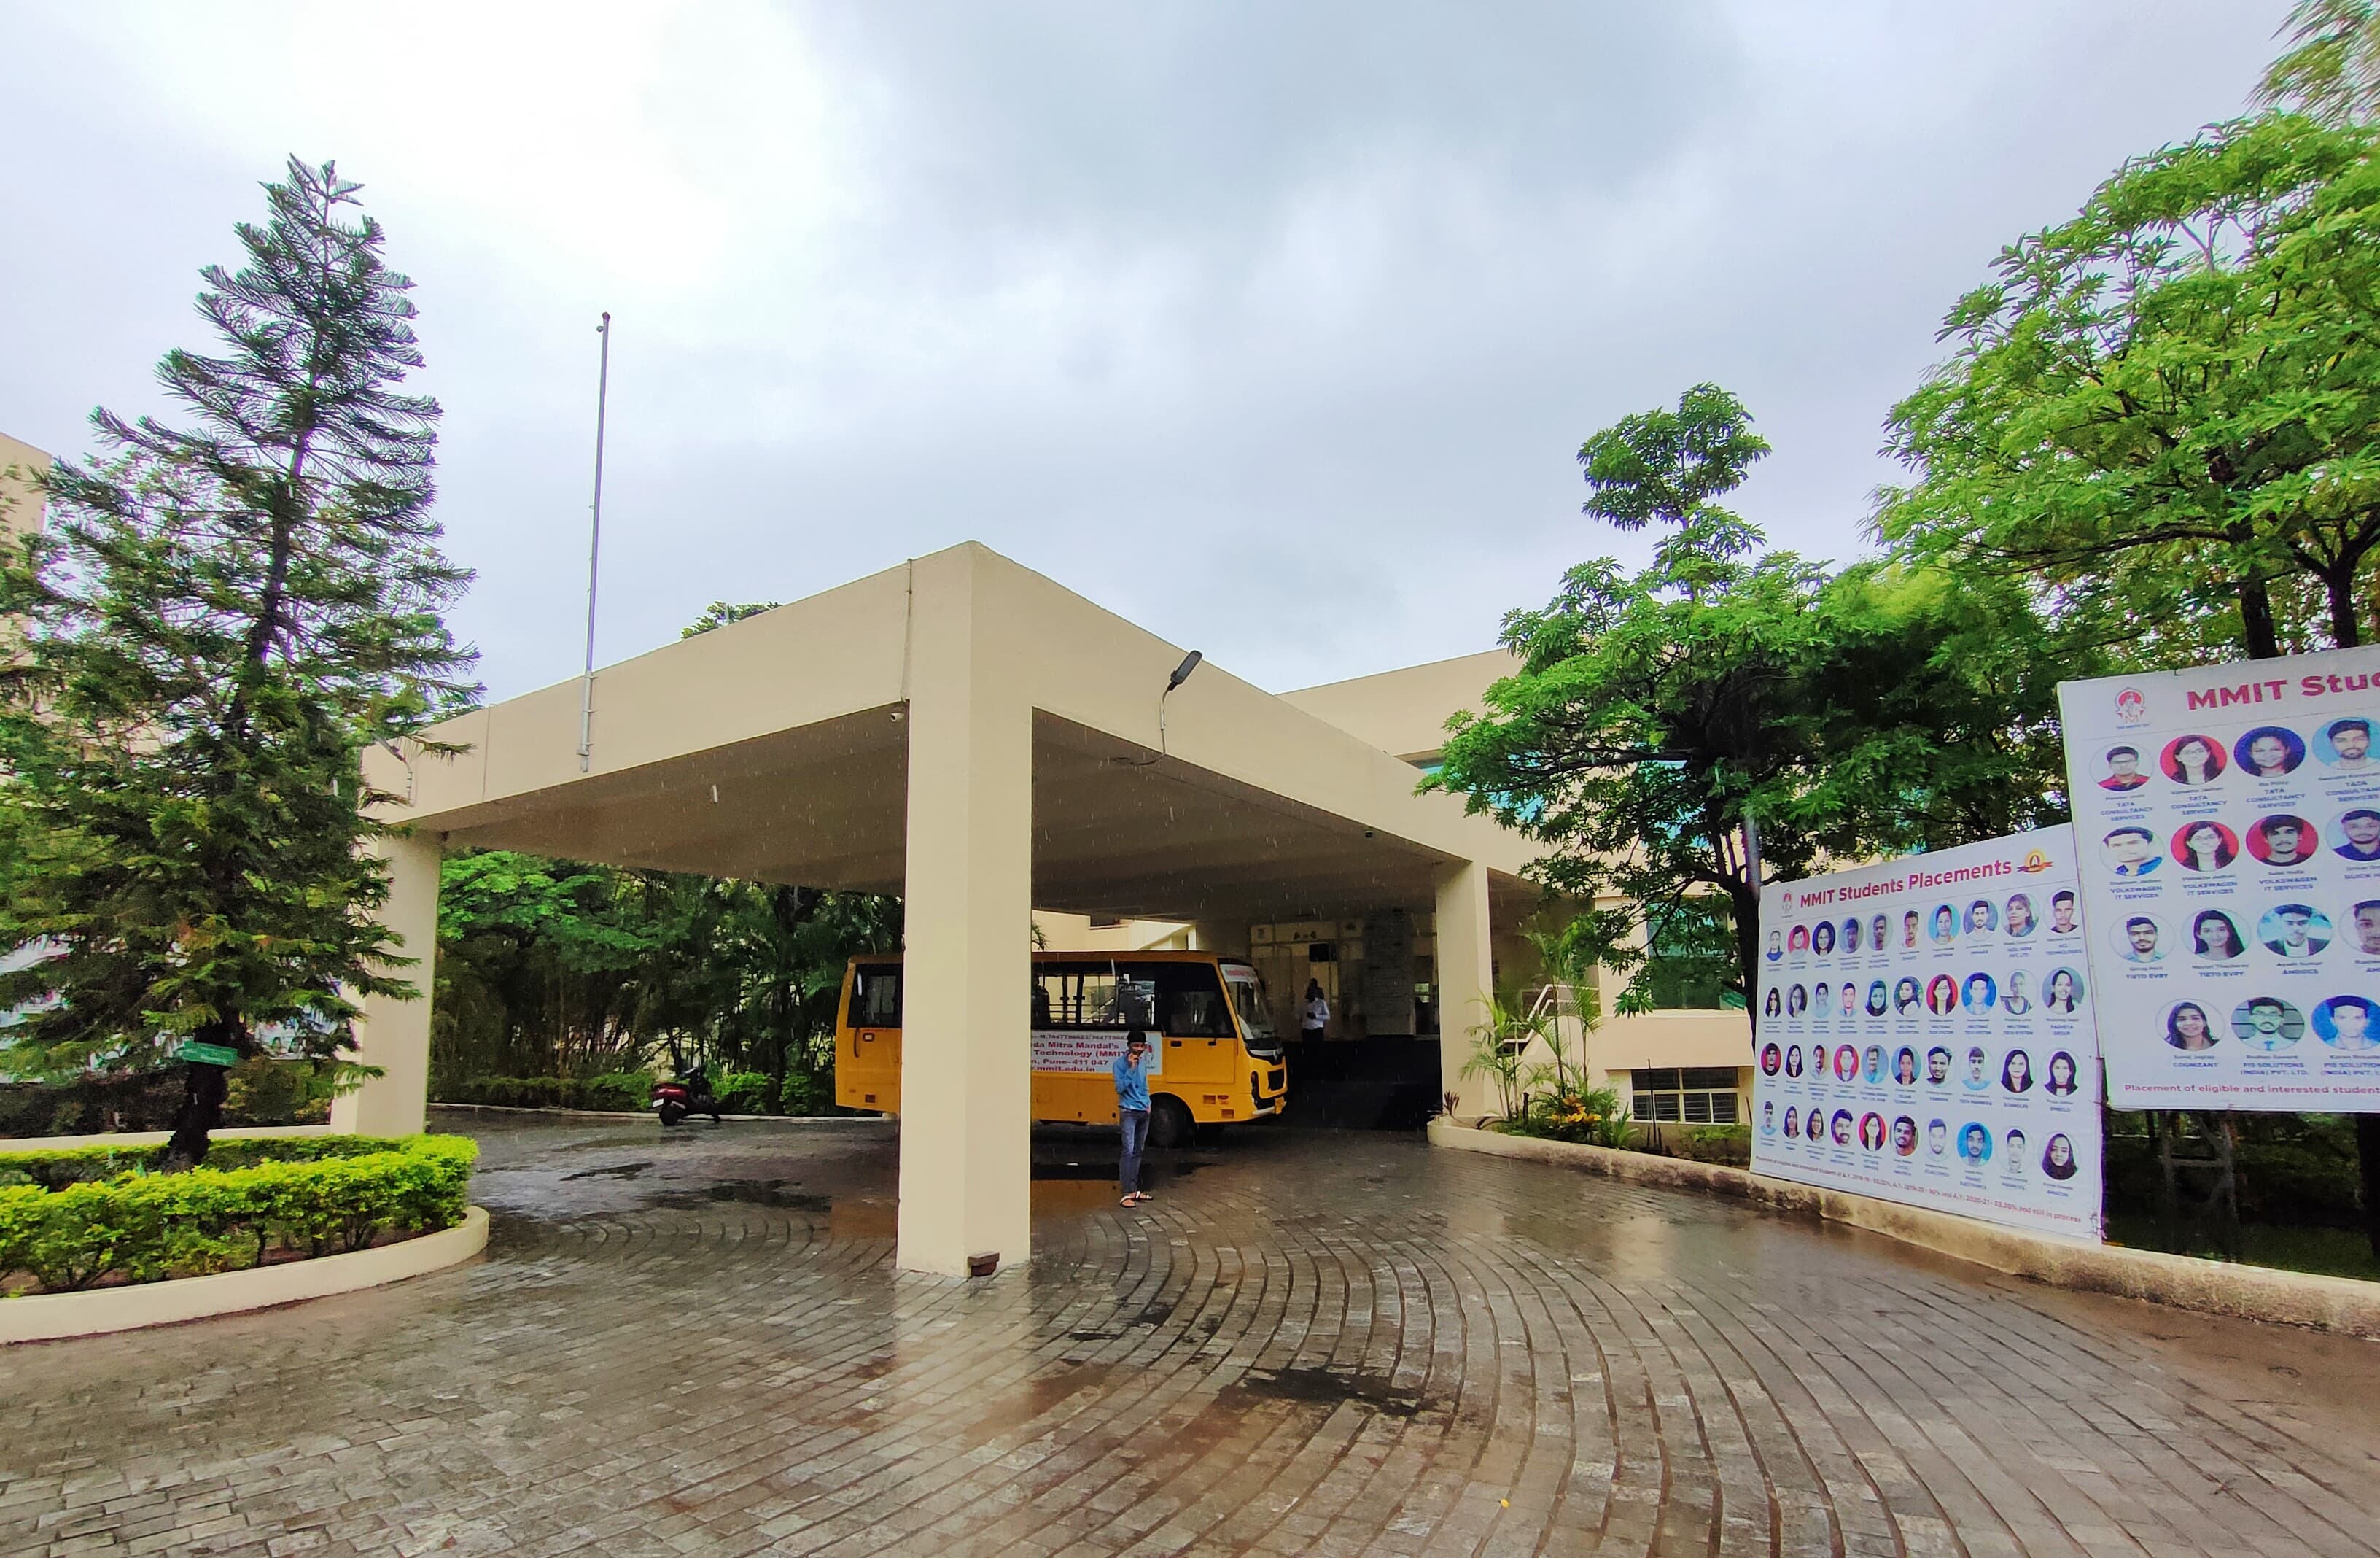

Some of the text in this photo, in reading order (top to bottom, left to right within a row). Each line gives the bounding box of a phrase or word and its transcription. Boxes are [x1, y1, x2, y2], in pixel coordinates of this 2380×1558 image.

[2188, 679, 2287, 710] MMIT
[1800, 859, 2012, 909] MMIT Students Placements
[1076, 1042, 1119, 1050] Mandal's
[1034, 1049, 1092, 1058] Technology
[2198, 1085, 2240, 1093] eligible
[2243, 1085, 2265, 1093] and
[2268, 1085, 2330, 1093] interested
[2053, 1213, 2082, 1223] process
